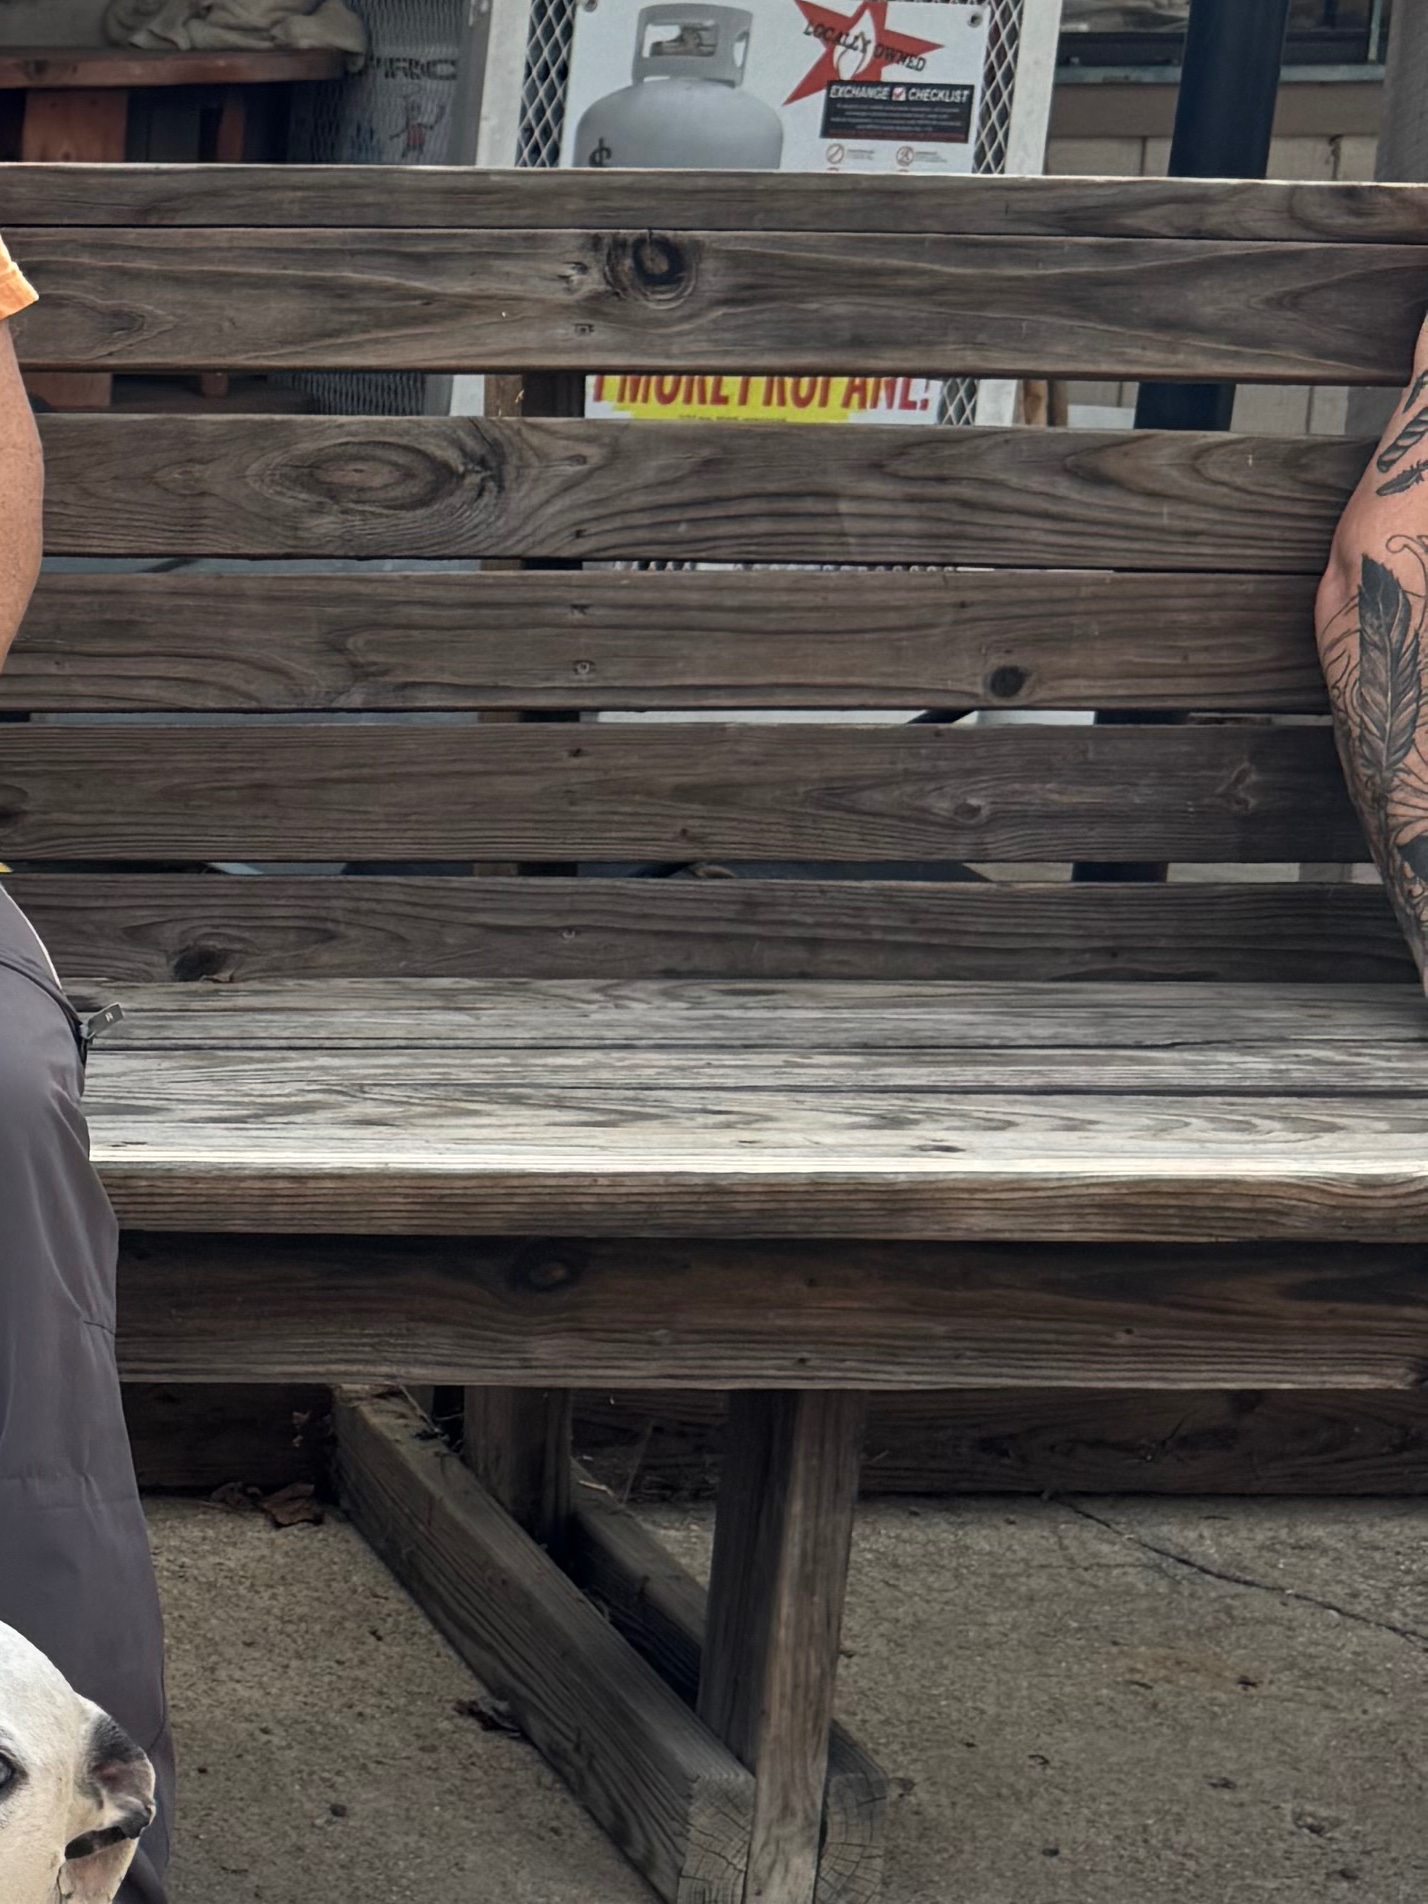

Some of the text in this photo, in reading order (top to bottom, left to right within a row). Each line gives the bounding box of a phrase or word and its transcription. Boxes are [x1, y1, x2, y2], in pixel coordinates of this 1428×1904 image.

[803, 22, 926, 73] LOCALLY OWNED
[829, 84, 970, 103] EXCHANGE CHECKLIST
